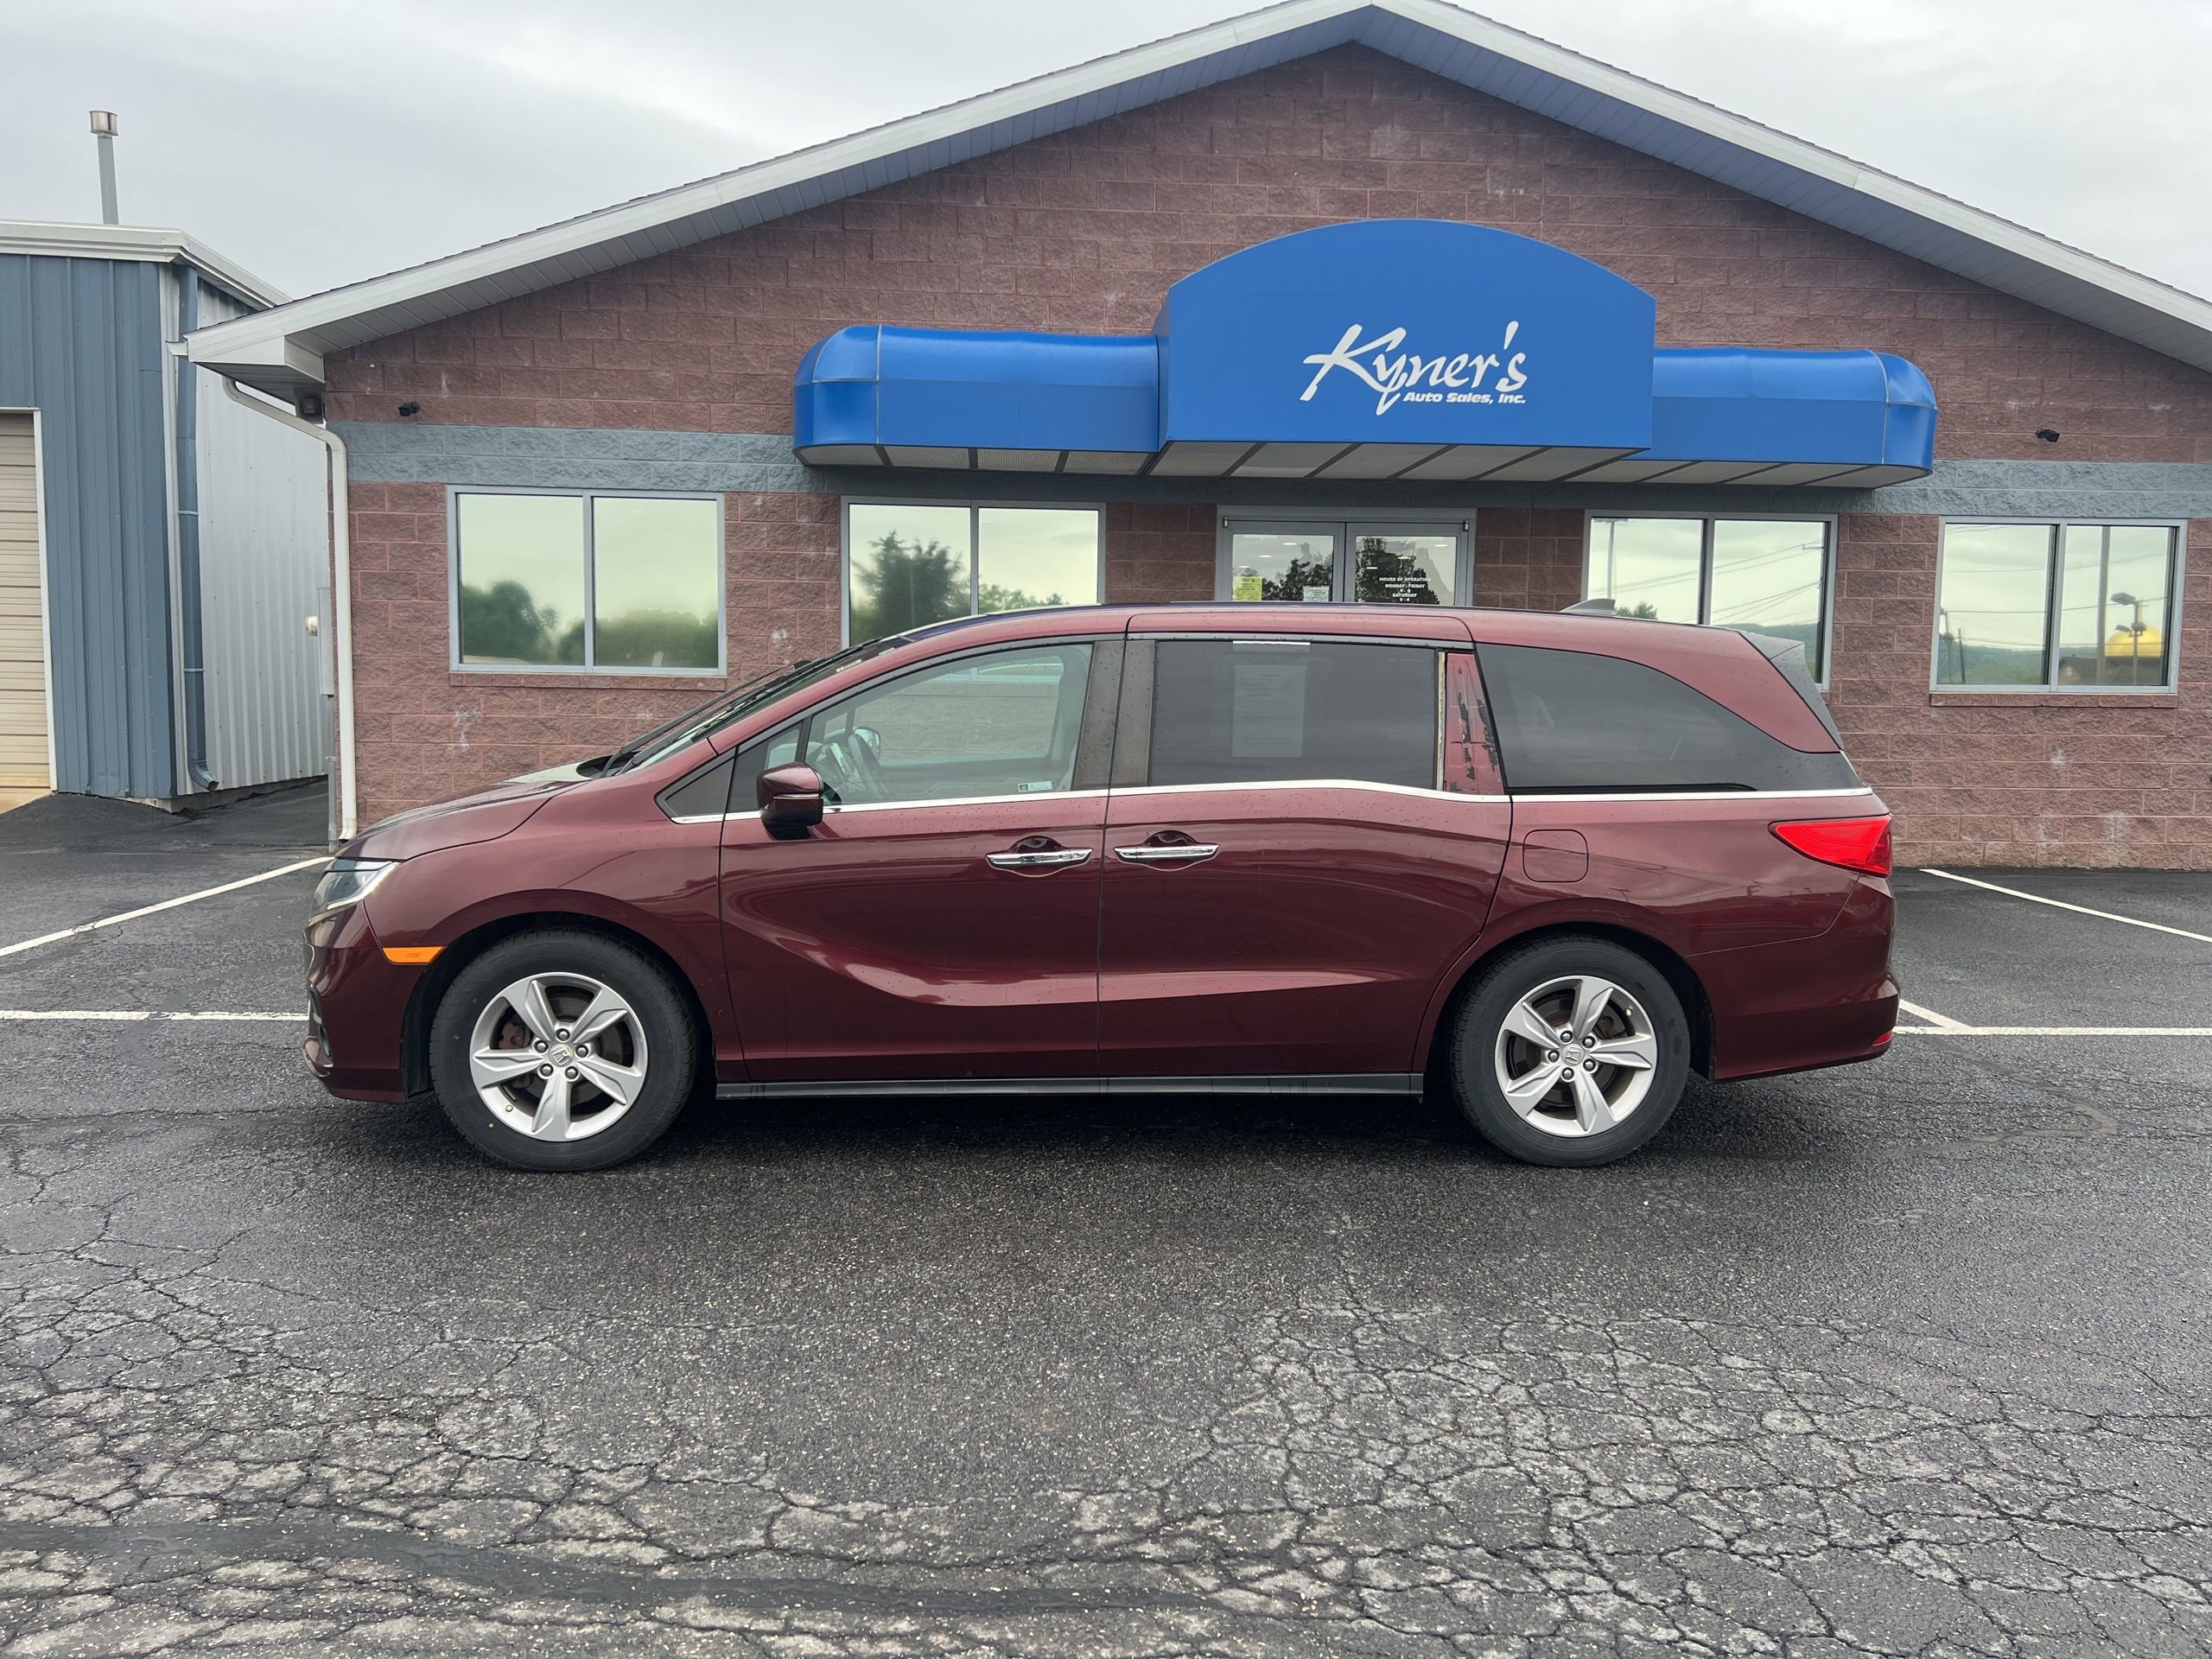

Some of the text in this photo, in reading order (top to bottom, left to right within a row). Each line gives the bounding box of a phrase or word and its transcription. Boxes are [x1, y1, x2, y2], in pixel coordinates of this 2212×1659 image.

[1300, 320, 1528, 416] Kyner's
[1402, 391, 1526, 404] Auto Sales, Inc.
